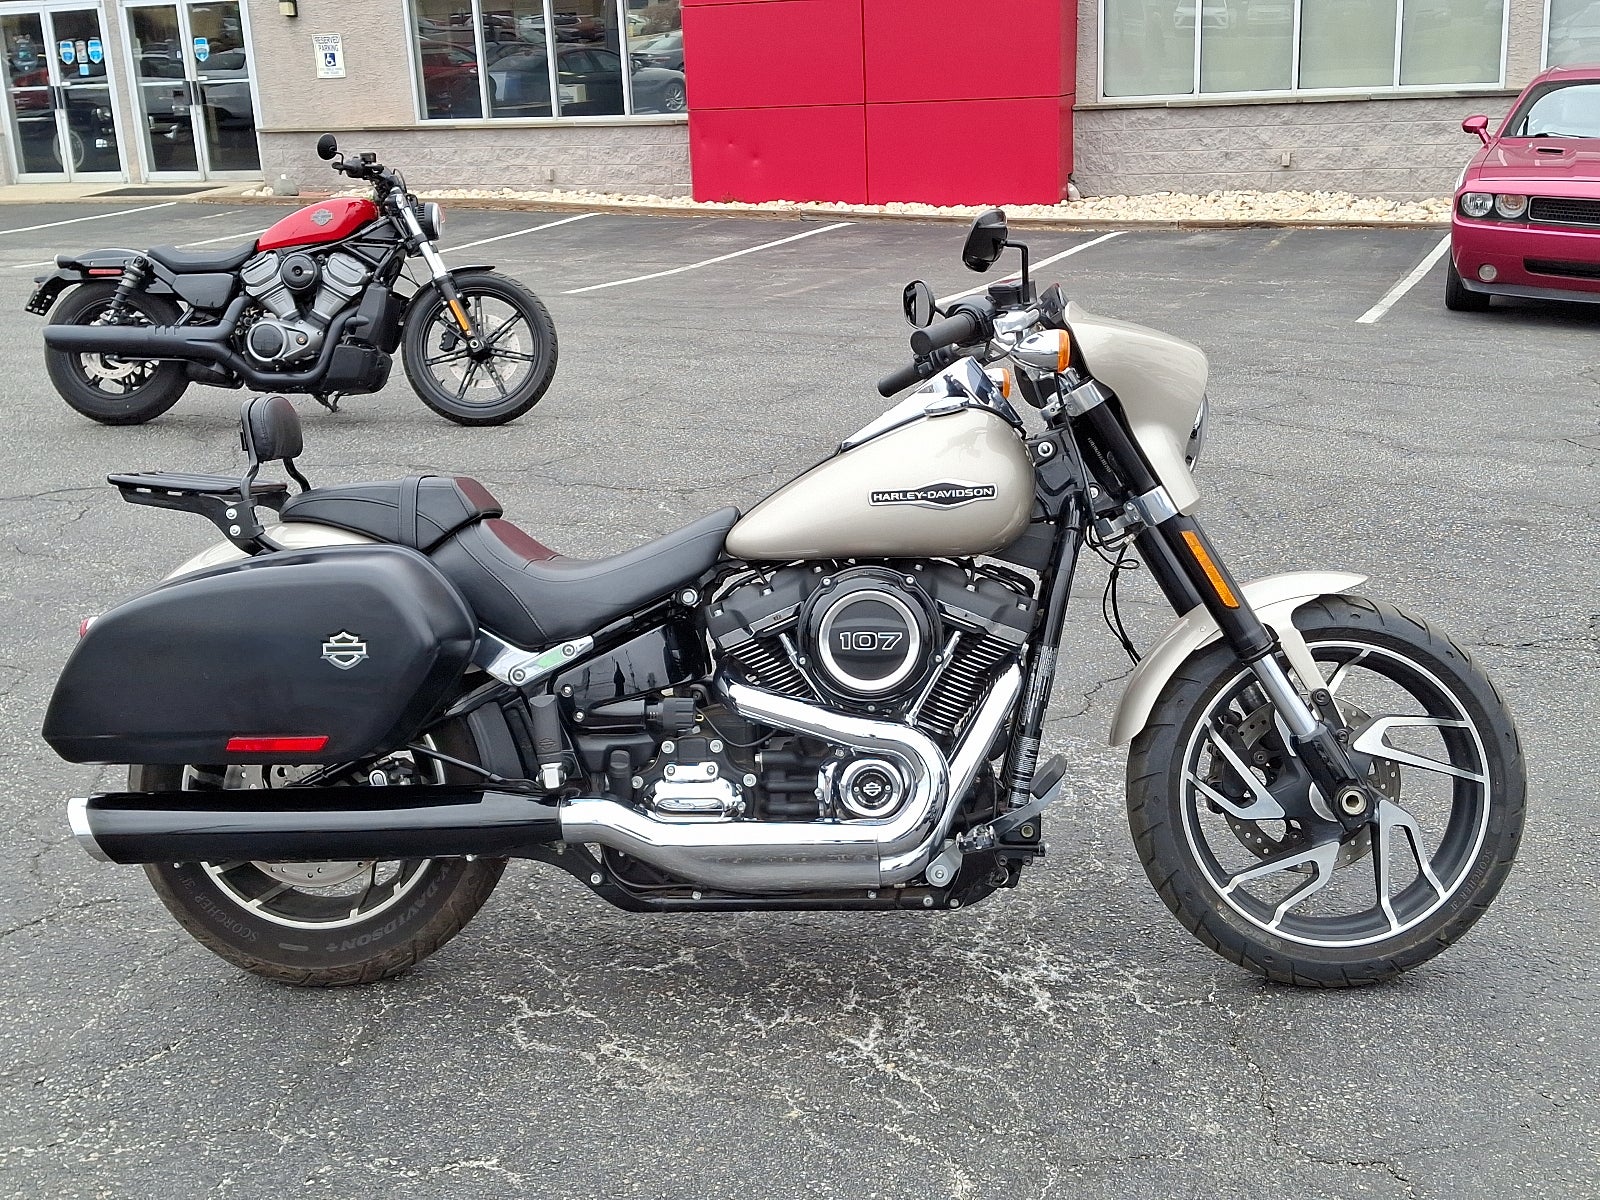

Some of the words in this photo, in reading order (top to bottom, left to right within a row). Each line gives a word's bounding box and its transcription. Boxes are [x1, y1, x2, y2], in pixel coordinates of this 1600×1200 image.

[873, 487, 993, 501] HARLEY-DAVIDSON
[839, 631, 903, 651] 107
[194, 892, 258, 942] SCORCHER
